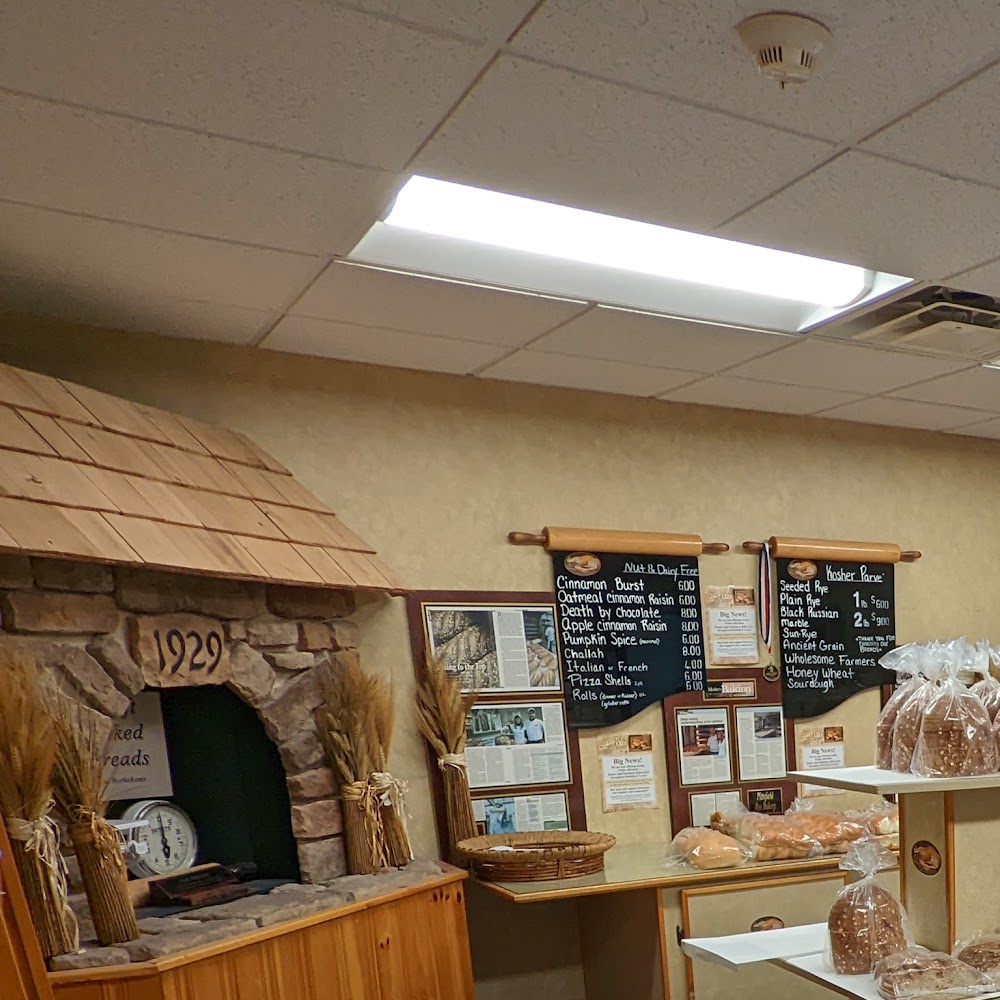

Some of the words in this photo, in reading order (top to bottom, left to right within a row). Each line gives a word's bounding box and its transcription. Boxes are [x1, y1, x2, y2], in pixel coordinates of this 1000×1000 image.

[624, 562, 645, 573] Nut
[648, 563, 656, 574] &
[657, 564, 678, 581] Dairy
[680, 565, 699, 575] Free
[826, 565, 855, 581] Kosher
[557, 575, 607, 590] Cinnamon
[615, 577, 644, 591] Burst
[780, 580, 810, 592] Seeded
[815, 580, 828, 596] Rye
[558, 590, 603, 603] Oatmeal
[649, 593, 674, 605] Raisin
[780, 592, 802, 605] Plain
[806, 594, 821, 608] Rye
[560, 604, 593, 617] Death
[599, 606, 611, 620] by
[781, 606, 804, 618] Black
[808, 607, 839, 618] Russian
[640, 620, 667, 632] Raisin
[563, 632, 607, 648] Pumpkin
[610, 632, 637, 647] Spice
[783, 639, 817, 651] Ancient
[819, 640, 844, 651] Grain
[153, 629, 222, 675] 1929
[565, 648, 604, 659] Challah
[785, 653, 836, 664] Wholesome
[838, 655, 875, 666] Farmers
[566, 660, 604, 672] Italian
[618, 661, 648, 672] French
[786, 666, 819, 681] Honey
[822, 668, 855, 679] Wheat
[567, 673, 602, 687] Pizza
[605, 673, 631, 686] Shells
[788, 678, 834, 693] Sourdough
[573, 689, 597, 700] Rolls
[721, 685, 752, 695] Baking
[114, 723, 145, 740] ked
